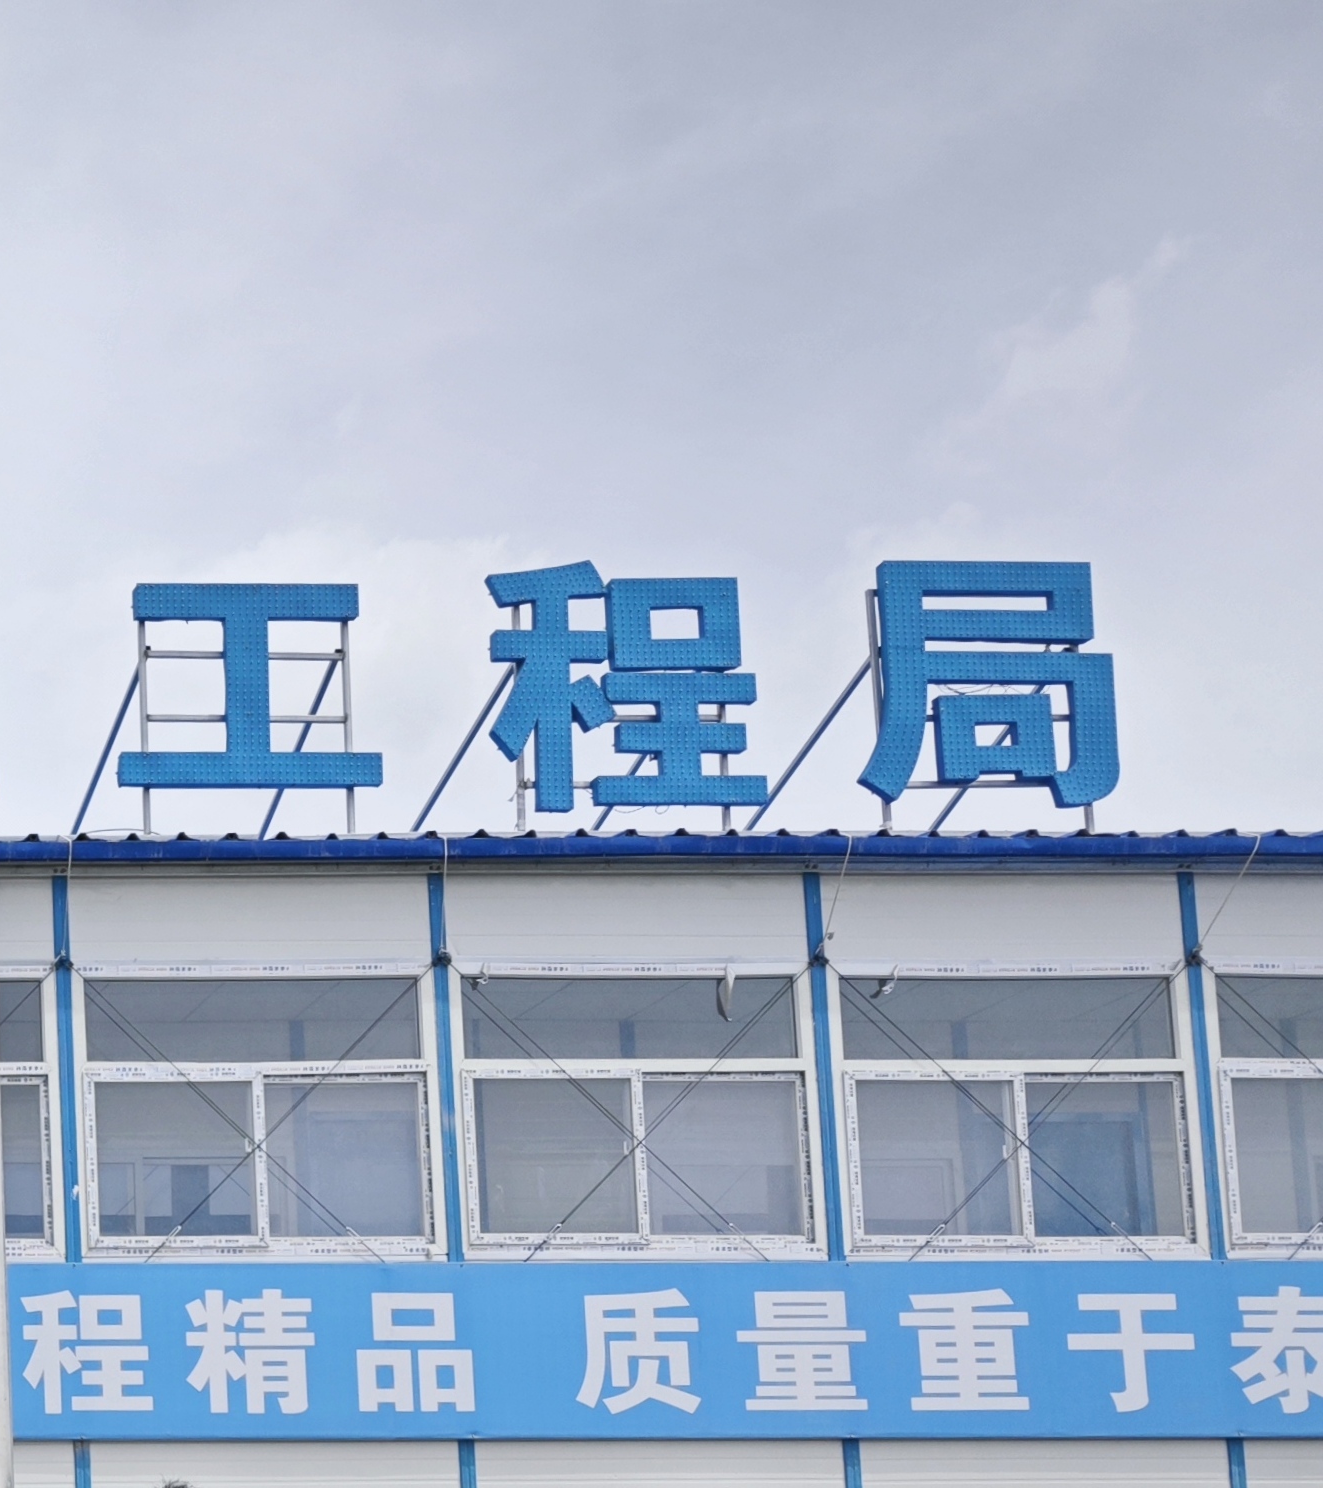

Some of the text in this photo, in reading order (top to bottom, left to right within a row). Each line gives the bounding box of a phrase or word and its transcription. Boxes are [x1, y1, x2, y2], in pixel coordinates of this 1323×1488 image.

[576, 1286, 1323, 1415] 质量重于泰
